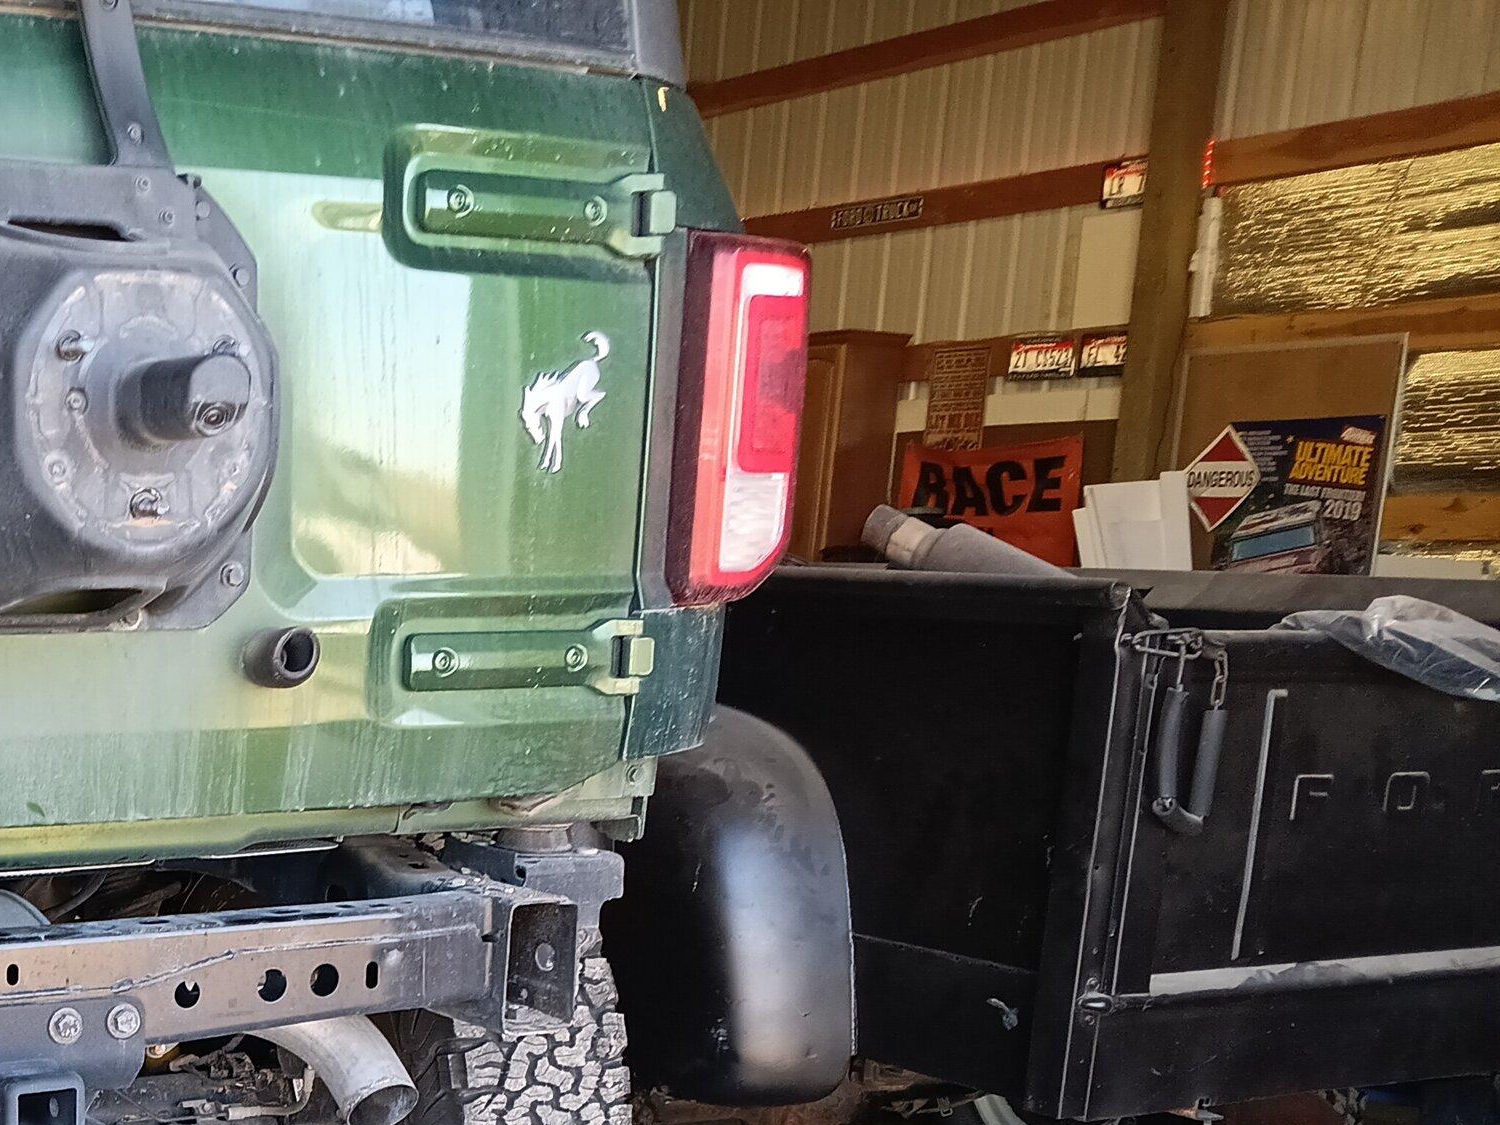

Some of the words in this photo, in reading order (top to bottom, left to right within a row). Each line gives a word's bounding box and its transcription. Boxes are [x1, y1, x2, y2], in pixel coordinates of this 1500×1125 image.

[1295, 440, 1375, 468] ULTIMATE
[911, 455, 1068, 517] RACE
[1187, 470, 1255, 488] DANGEROUS
[1288, 460, 1369, 486] ADVENTURE
[1322, 499, 1363, 521] 2019
